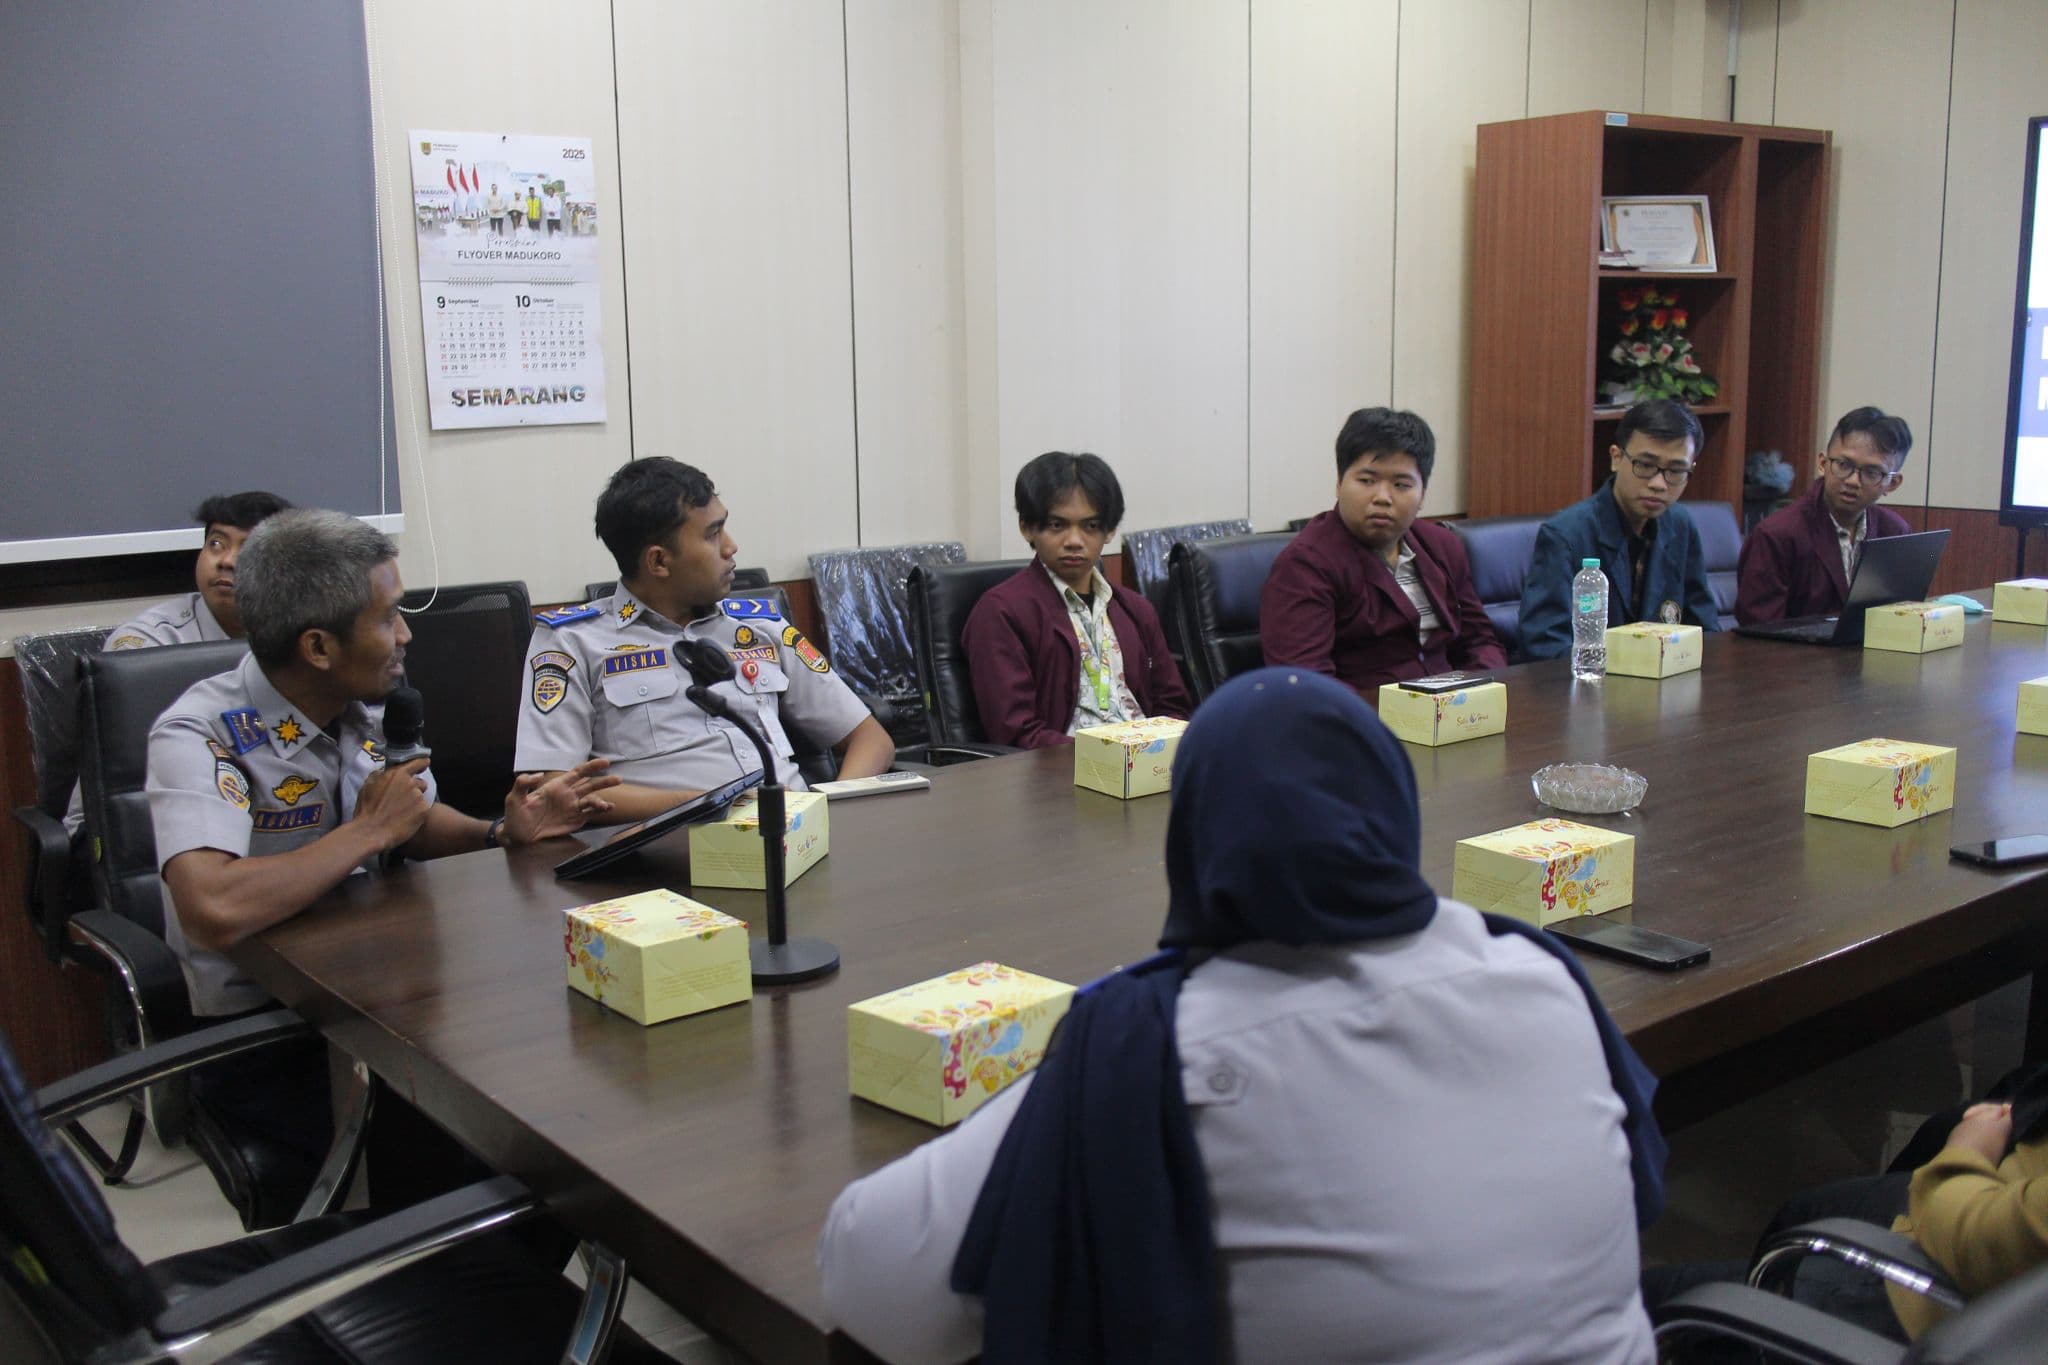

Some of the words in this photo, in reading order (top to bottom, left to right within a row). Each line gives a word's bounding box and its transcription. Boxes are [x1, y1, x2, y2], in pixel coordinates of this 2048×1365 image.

[562, 148, 586, 160] 2025
[457, 250, 503, 261] FLYOVER
[504, 251, 562, 261] MADUKORO
[436, 295, 446, 310] 9
[515, 294, 531, 309] 10
[451, 384, 587, 408] SEMARANG
[614, 652, 659, 671] VISNA
